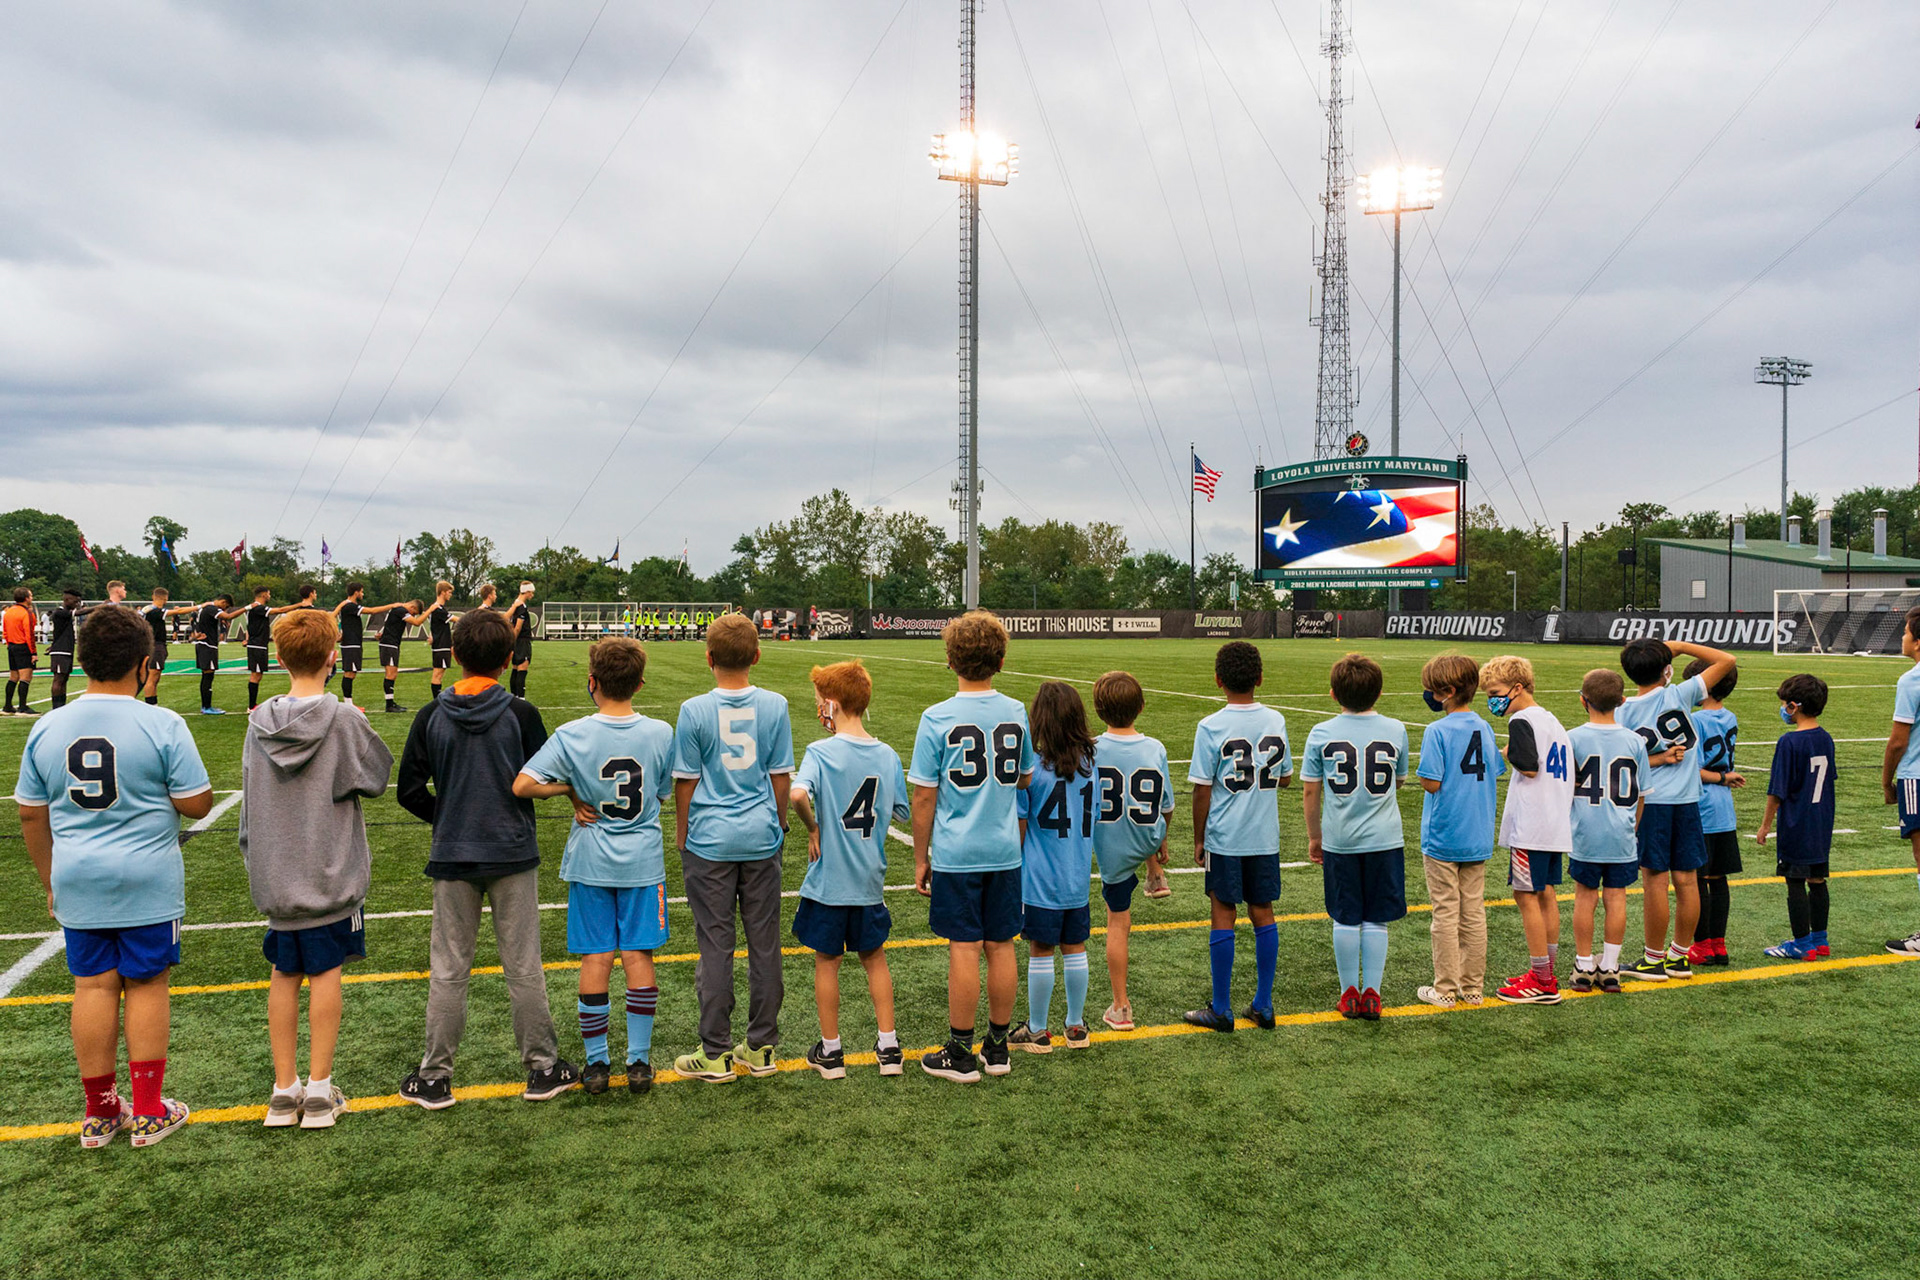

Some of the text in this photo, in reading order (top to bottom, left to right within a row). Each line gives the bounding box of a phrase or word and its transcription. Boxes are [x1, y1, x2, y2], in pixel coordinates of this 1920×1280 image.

[1271, 461, 1448, 481] LOYOLA UNIVERSITY MARYLAND
[1357, 580, 1387, 588] NATIONAL
[997, 617, 1042, 632] OTECT
[1044, 617, 1065, 632] THIS
[1296, 615, 1325, 627] Fence
[718, 708, 757, 770] 5
[946, 722, 1024, 788] 38
[1220, 735, 1286, 794] 32
[1460, 730, 1486, 782] 4
[1546, 741, 1567, 782] 41
[66, 736, 119, 811] 9
[599, 756, 645, 821] 3
[1097, 766, 1165, 826] 39
[1322, 740, 1397, 796] 36
[1575, 754, 1639, 809] 40
[1810, 755, 1829, 803] 7
[841, 776, 880, 840] 4
[1037, 780, 1093, 839] 41
